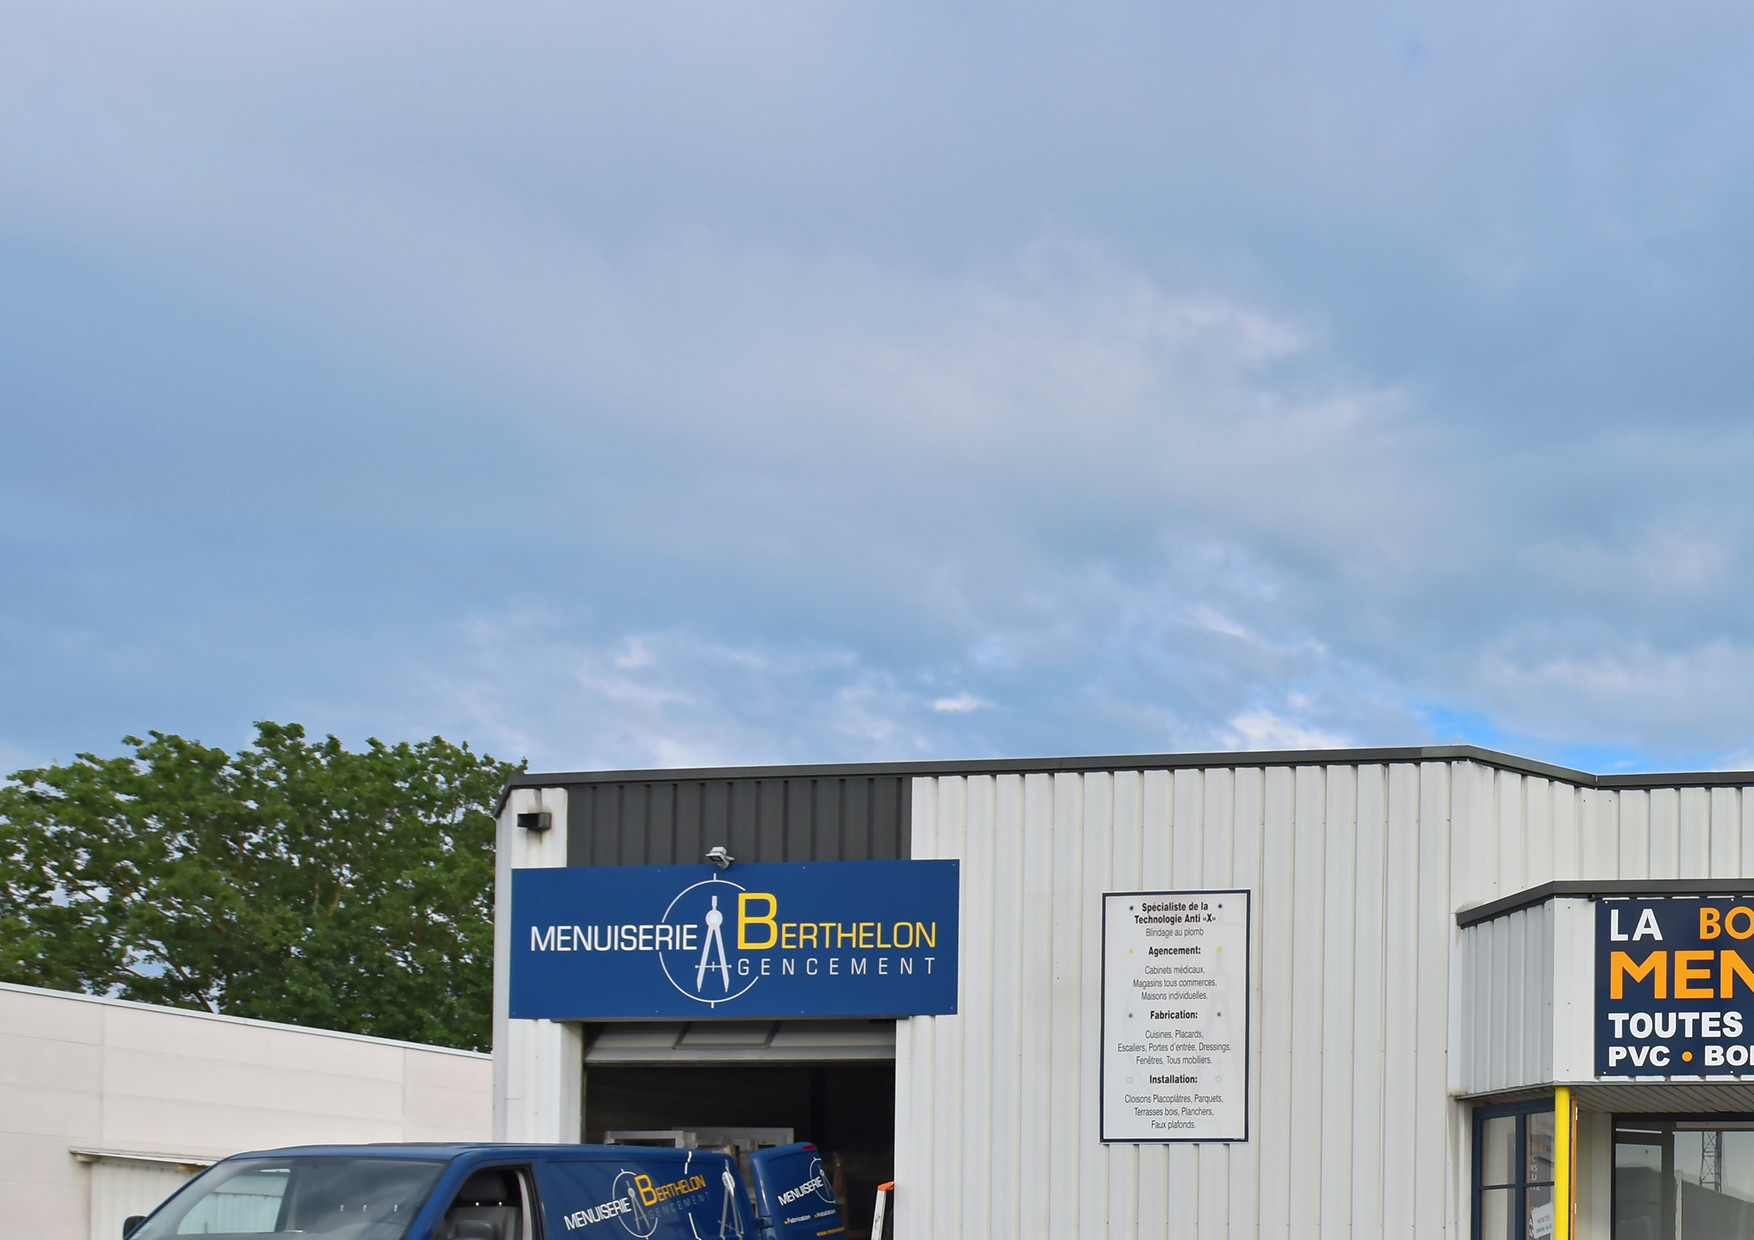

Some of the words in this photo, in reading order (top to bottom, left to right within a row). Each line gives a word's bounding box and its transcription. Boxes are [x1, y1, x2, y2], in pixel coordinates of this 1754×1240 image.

[1141, 902, 1186, 914] Spécialiste
[1188, 902, 1198, 911] de
[1200, 902, 1209, 910] la
[530, 924, 698, 952] MENUISERIE
[737, 892, 936, 950] BERTHELON
[1134, 914, 1182, 925] Technologie
[1184, 914, 1201, 923] Anti
[1610, 908, 1663, 941] LA
[1145, 928, 1173, 938] Blindage
[1184, 927, 1204, 938] plomb
[1148, 946, 1201, 957] Agencement:
[1144, 965, 1172, 974] Cabinets
[1133, 979, 1162, 989] Magasins
[1163, 980, 1178, 988] tous
[1141, 991, 1167, 1000] Maisons
[1150, 1010, 1198, 1019] Fabrication:
[1608, 1012, 1743, 1038] TOUTES
[1148, 1042, 1168, 1051] Portes
[1166, 1055, 1181, 1064] Tous
[1608, 1046, 1670, 1067] PVC
[1149, 1074, 1198, 1083] Installation:
[1124, 1094, 1152, 1103] Cloisons
[1134, 1107, 1163, 1116] Terrasses
[1151, 1120, 1166, 1129] Faux
[777, 1176, 823, 1206] MENUISERIE
[564, 1197, 632, 1230] MENUISERIE
[634, 1174, 706, 1207] BERTHELON
